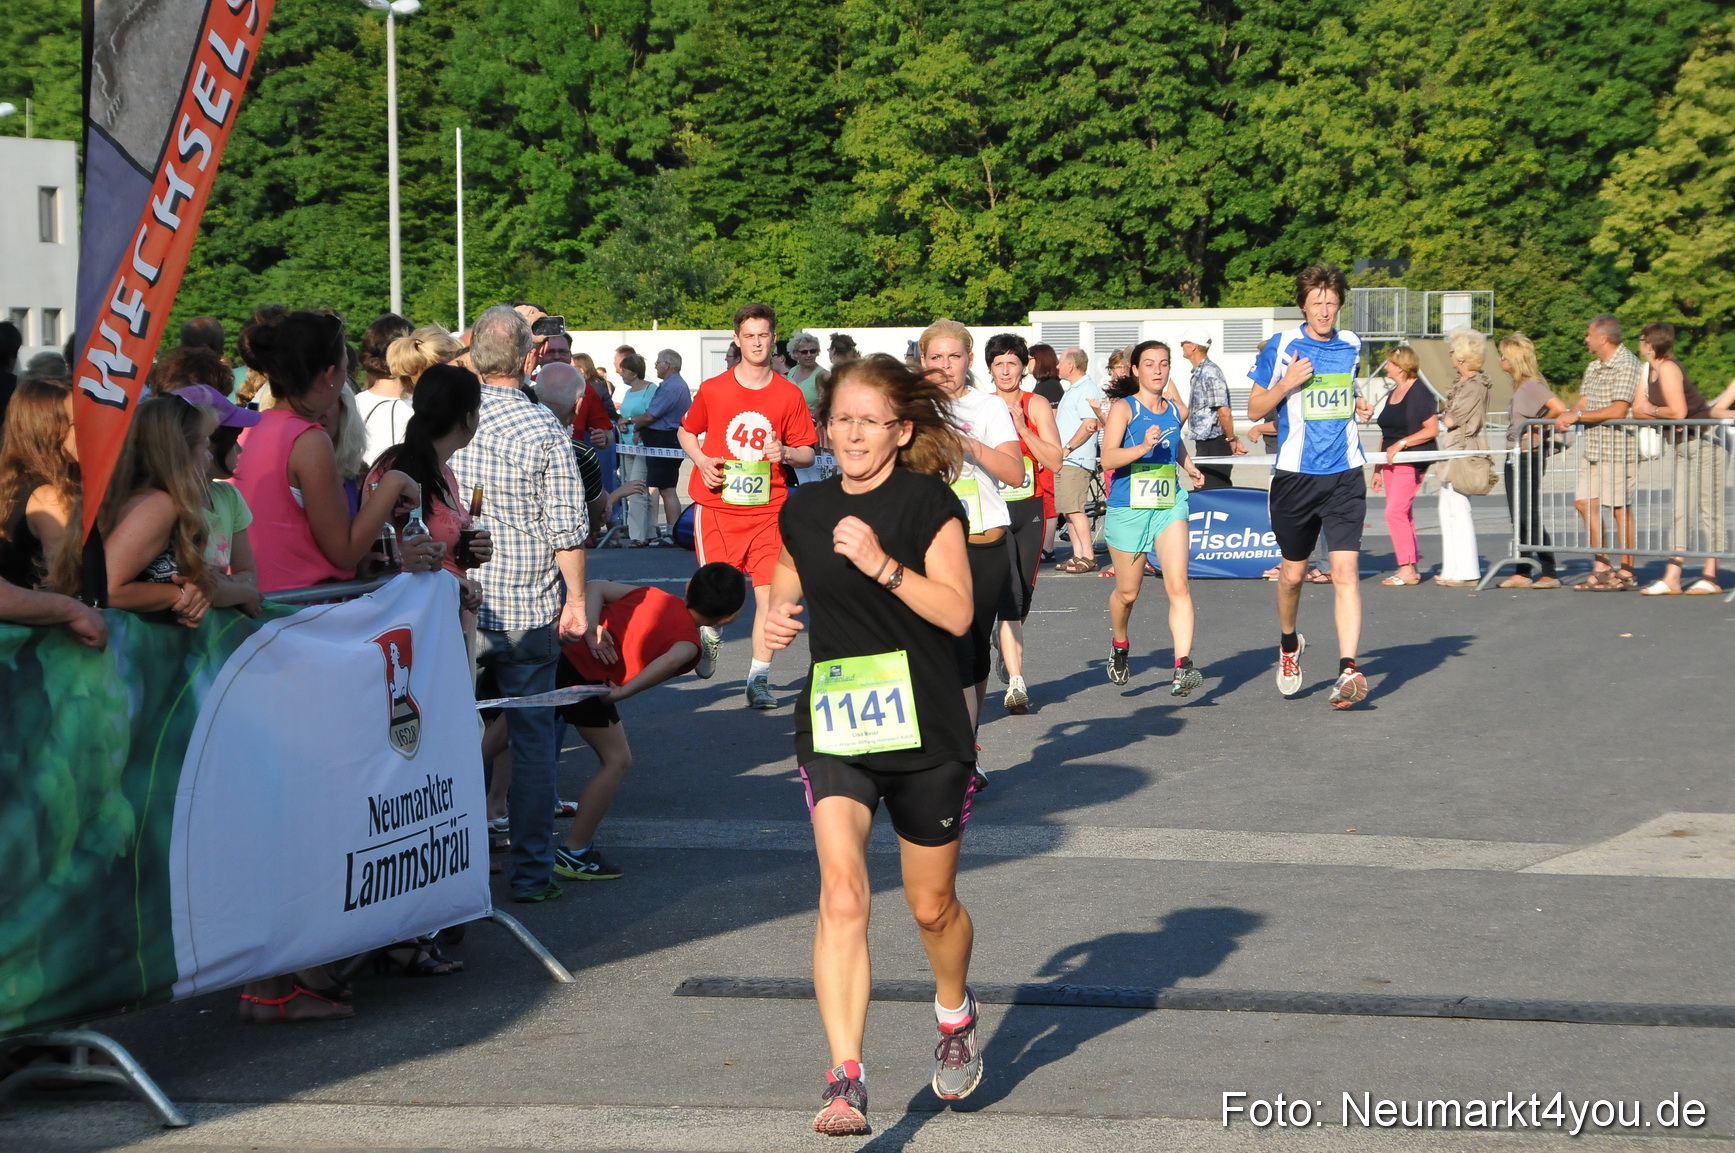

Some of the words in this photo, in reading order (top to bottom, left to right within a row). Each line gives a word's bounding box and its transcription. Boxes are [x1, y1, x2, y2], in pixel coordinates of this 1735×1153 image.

[1306, 389, 1348, 408] 1041
[732, 423, 767, 450] 48
[730, 476, 764, 494] 462
[1138, 479, 1170, 498] 740
[815, 687, 906, 732] 1141
[395, 725, 418, 747] 1628
[368, 774, 453, 837] Neumarkter
[343, 818, 470, 912] Lammsbräu
